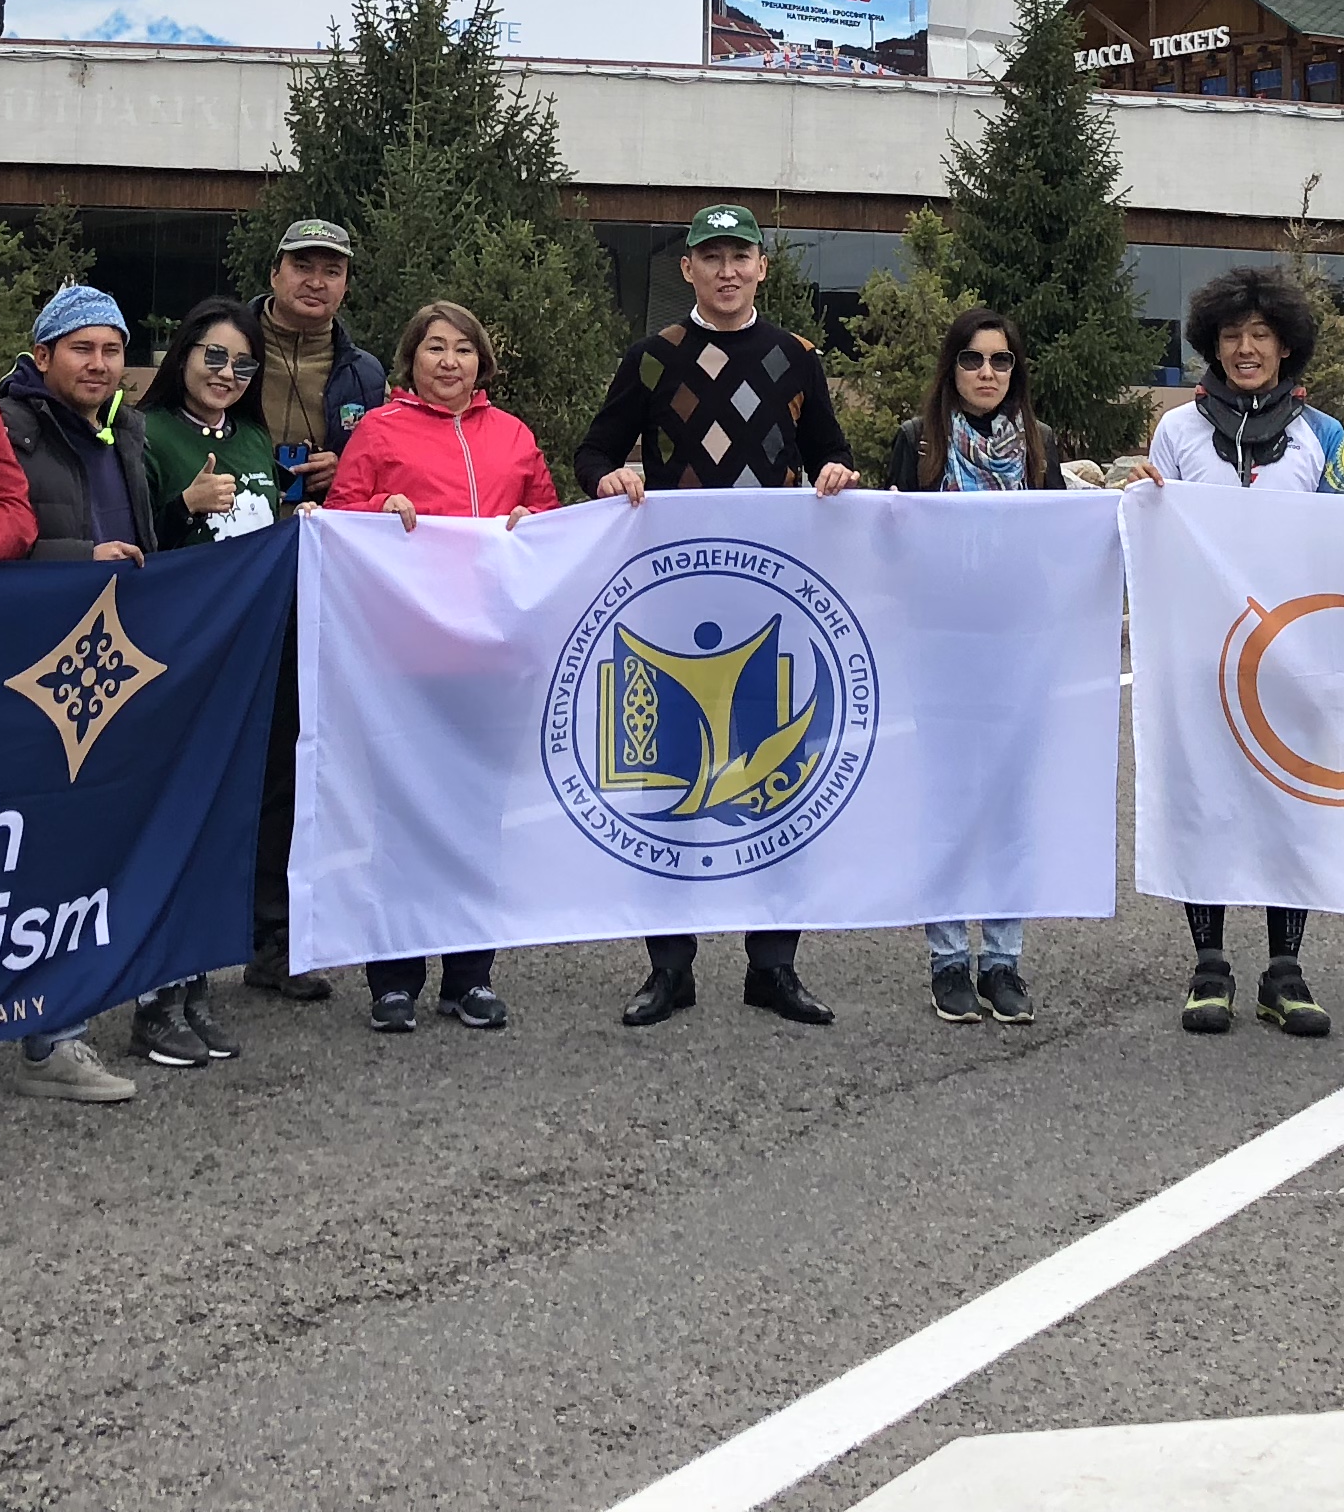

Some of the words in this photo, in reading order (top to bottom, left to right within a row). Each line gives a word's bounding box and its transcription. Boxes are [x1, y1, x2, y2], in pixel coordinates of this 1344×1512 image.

[1150, 26, 1230, 59] TICKETS
[651, 549, 786, 580] МӘДЕНИЕТ
[795, 578, 851, 640] ЖӘНЕ
[551, 576, 633, 754] РЕСПУБЛИКАСЫ
[848, 653, 870, 730] СПОРТ
[561, 774, 681, 868] ҚАЗАҚСТАН
[735, 751, 860, 866] МИНИСТРЛІГІ
